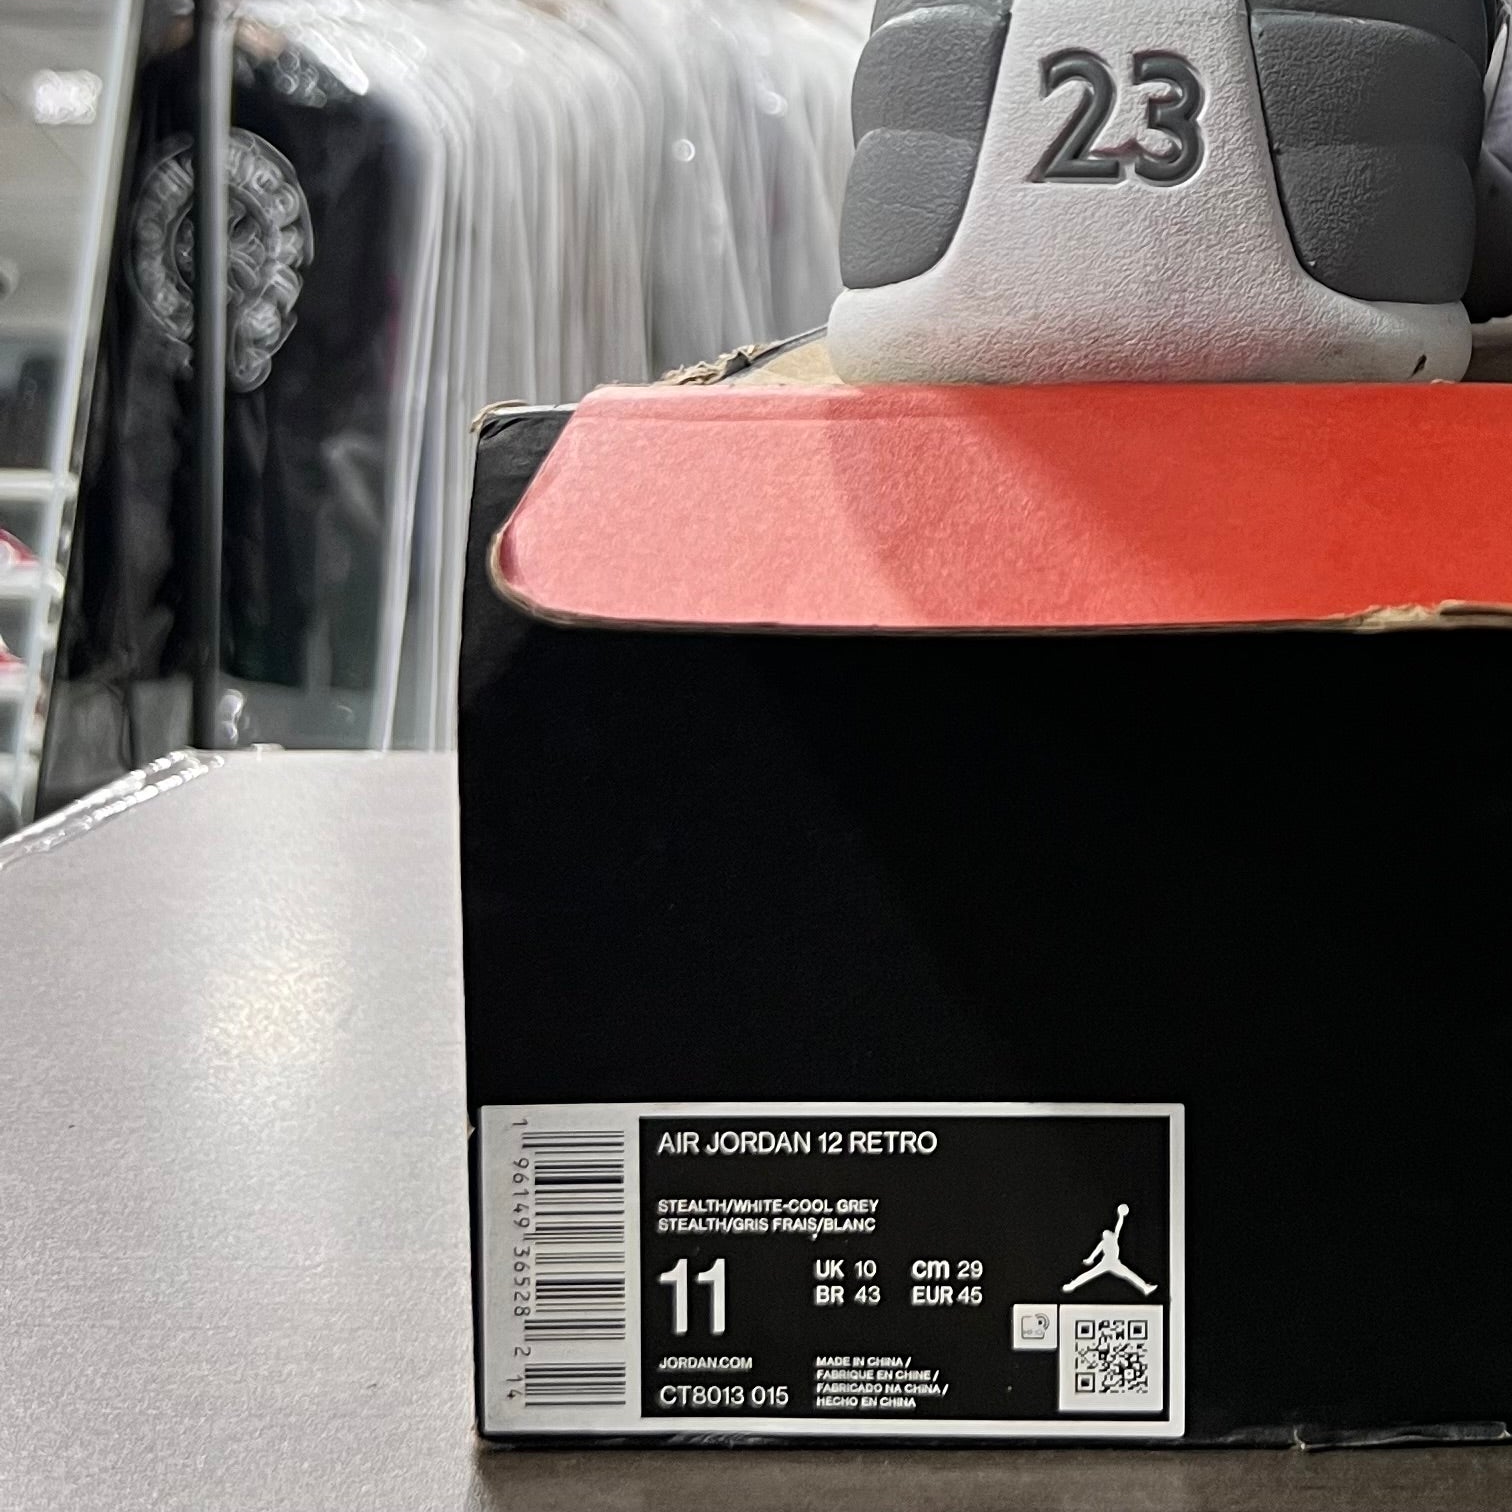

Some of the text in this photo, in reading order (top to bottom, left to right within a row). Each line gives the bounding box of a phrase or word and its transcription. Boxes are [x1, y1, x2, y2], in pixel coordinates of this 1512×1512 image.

[1026, 47, 1206, 187] 23
[658, 1131, 938, 1155] AIR JORDAN 12 RETRO
[512, 1157, 530, 1228] 96149
[658, 1198, 879, 1213] STEALTH/WHITE-COOL GREY
[658, 1217, 876, 1233] STEALTH/GRIS FRAIS/BLANC
[815, 1259, 877, 1279] UK 10
[911, 1259, 983, 1279] cm 29
[513, 1246, 531, 1317] 36528
[660, 1258, 725, 1334] 11
[815, 1285, 881, 1305] BR 43
[911, 1285, 983, 1305] EUR 45
[513, 1346, 531, 1357] 2
[816, 1356, 850, 1367] MADE
[852, 1356, 865, 1367] IN
[867, 1356, 903, 1367] CHINA
[658, 1356, 753, 1370] JORDAN.COM
[816, 1369, 875, 1381] FABRIQUE
[877, 1369, 893, 1381] EN
[895, 1369, 931, 1381] CHINE
[506, 1377, 524, 1400] 14
[660, 1385, 789, 1407] CT8013 015
[816, 1383, 883, 1394] FABRICADO
[885, 1383, 902, 1394] NA
[904, 1383, 941, 1395] CHINA
[816, 1396, 916, 1408] HECHO EN CHINA
